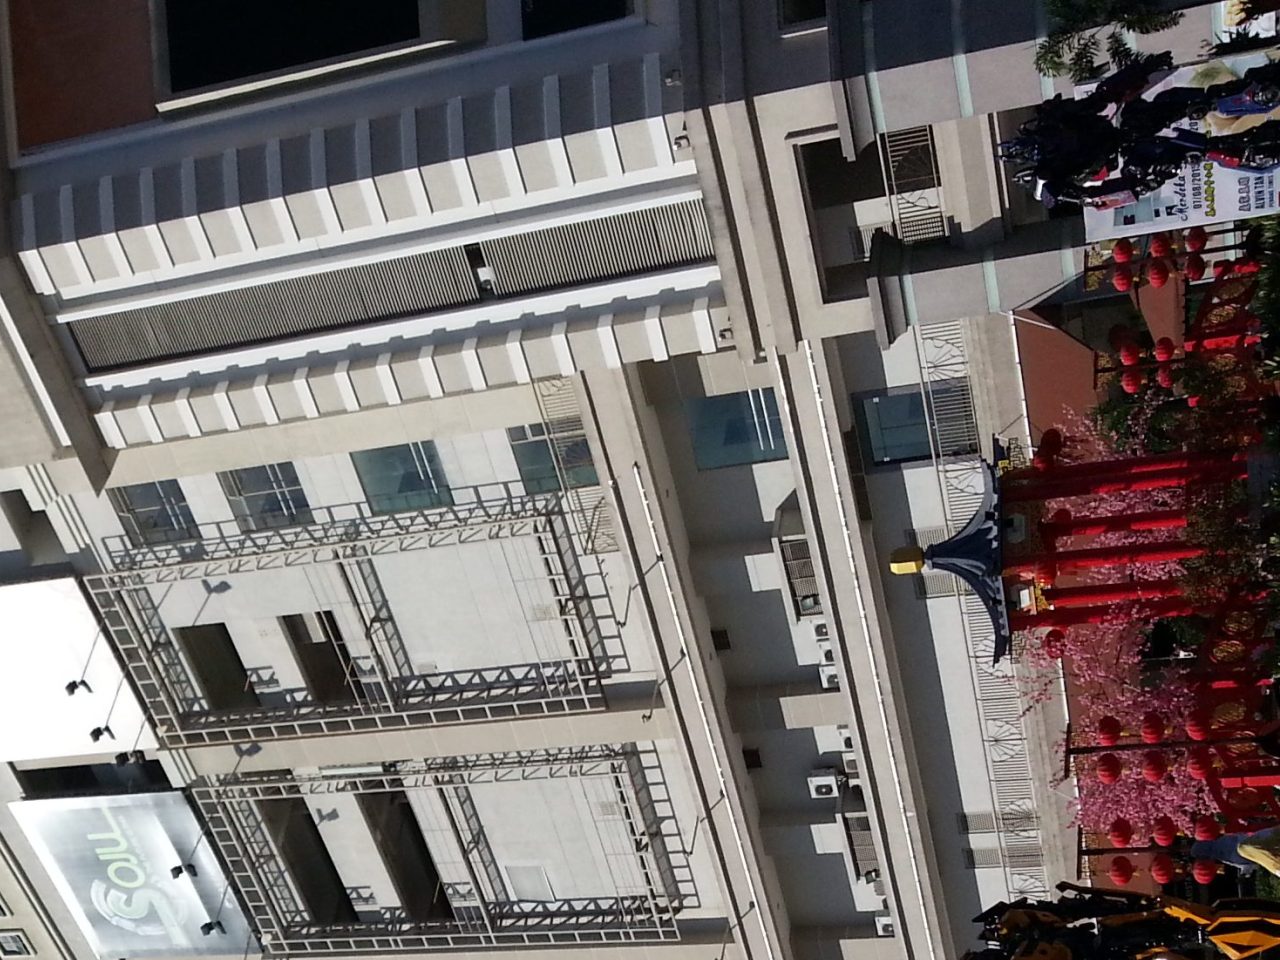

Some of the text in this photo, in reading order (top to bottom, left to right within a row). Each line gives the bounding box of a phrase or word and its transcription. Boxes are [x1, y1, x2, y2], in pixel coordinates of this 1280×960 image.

[1173, 175, 1189, 221] Merdeka
[1253, 176, 1266, 209] ALVIN TAN
[87, 833, 168, 919] SOJU
